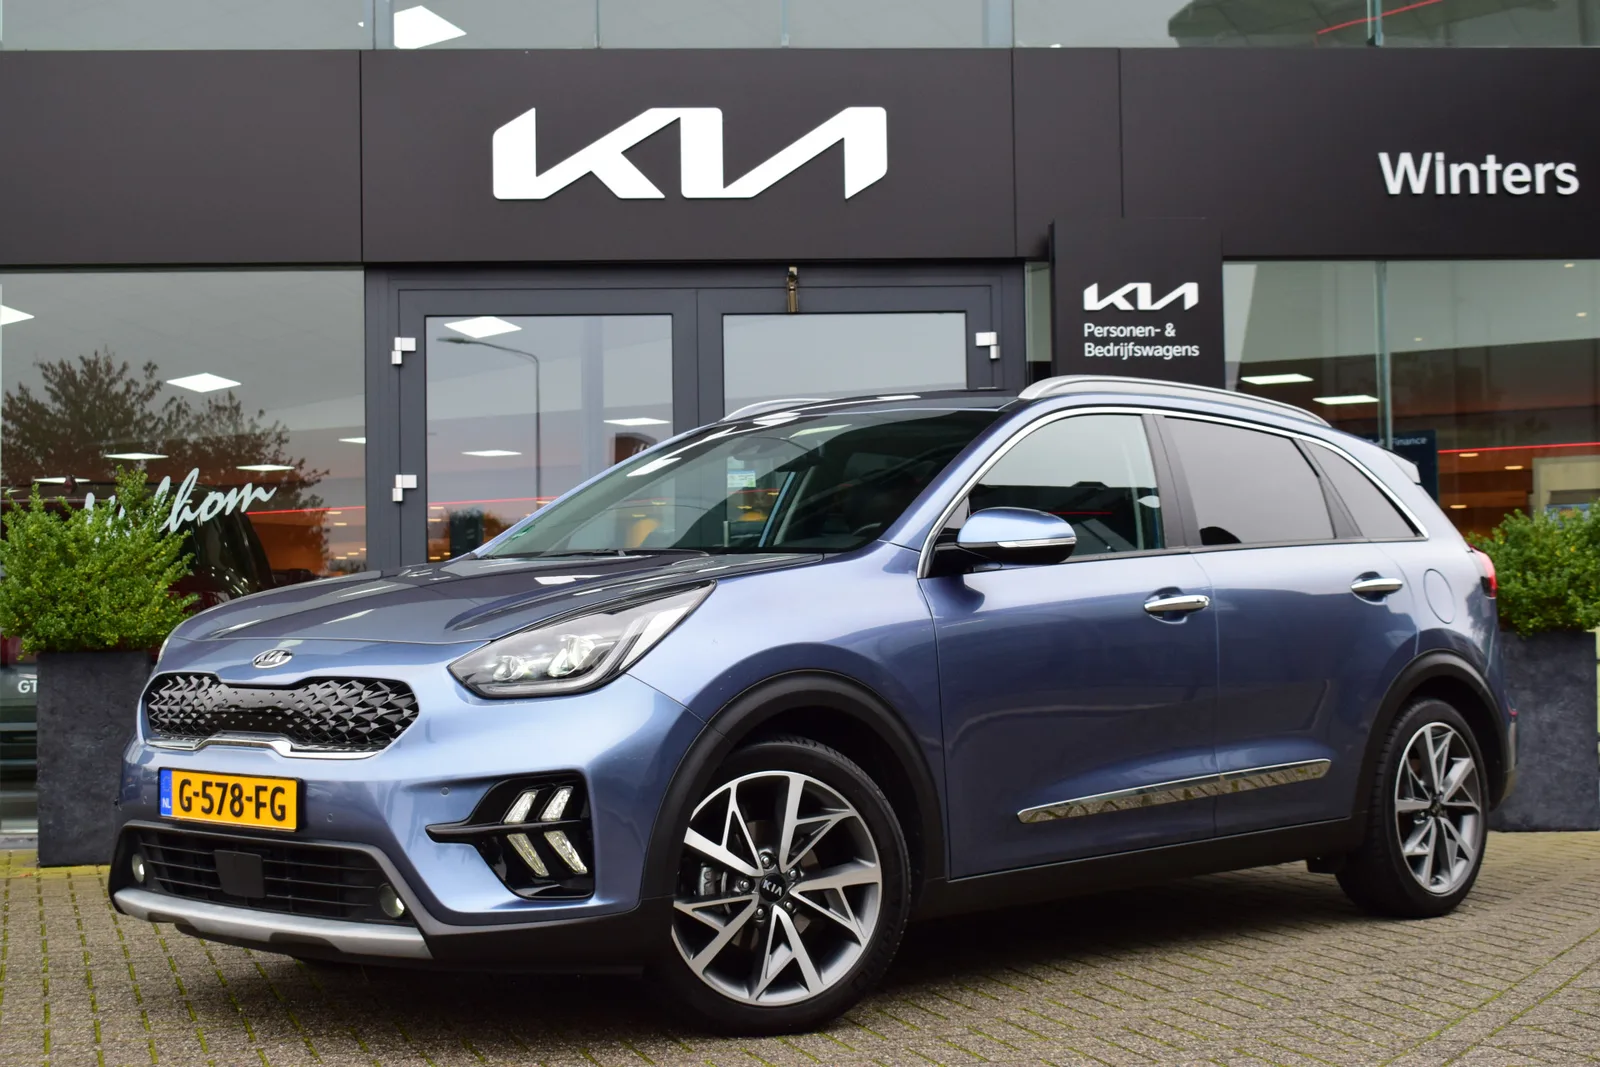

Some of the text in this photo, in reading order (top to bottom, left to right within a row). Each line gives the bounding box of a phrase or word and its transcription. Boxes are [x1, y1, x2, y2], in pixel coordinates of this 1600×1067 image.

[492, 106, 888, 200] KIA
[1378, 152, 1580, 195] Winters
[1083, 282, 1199, 311] KIA
[1084, 322, 1176, 338] Personen- &
[1084, 342, 1200, 360] Bedrijfswagens
[162, 797, 171, 808] NL
[179, 778, 286, 822] G-578-FG
[762, 880, 782, 896] KIA
